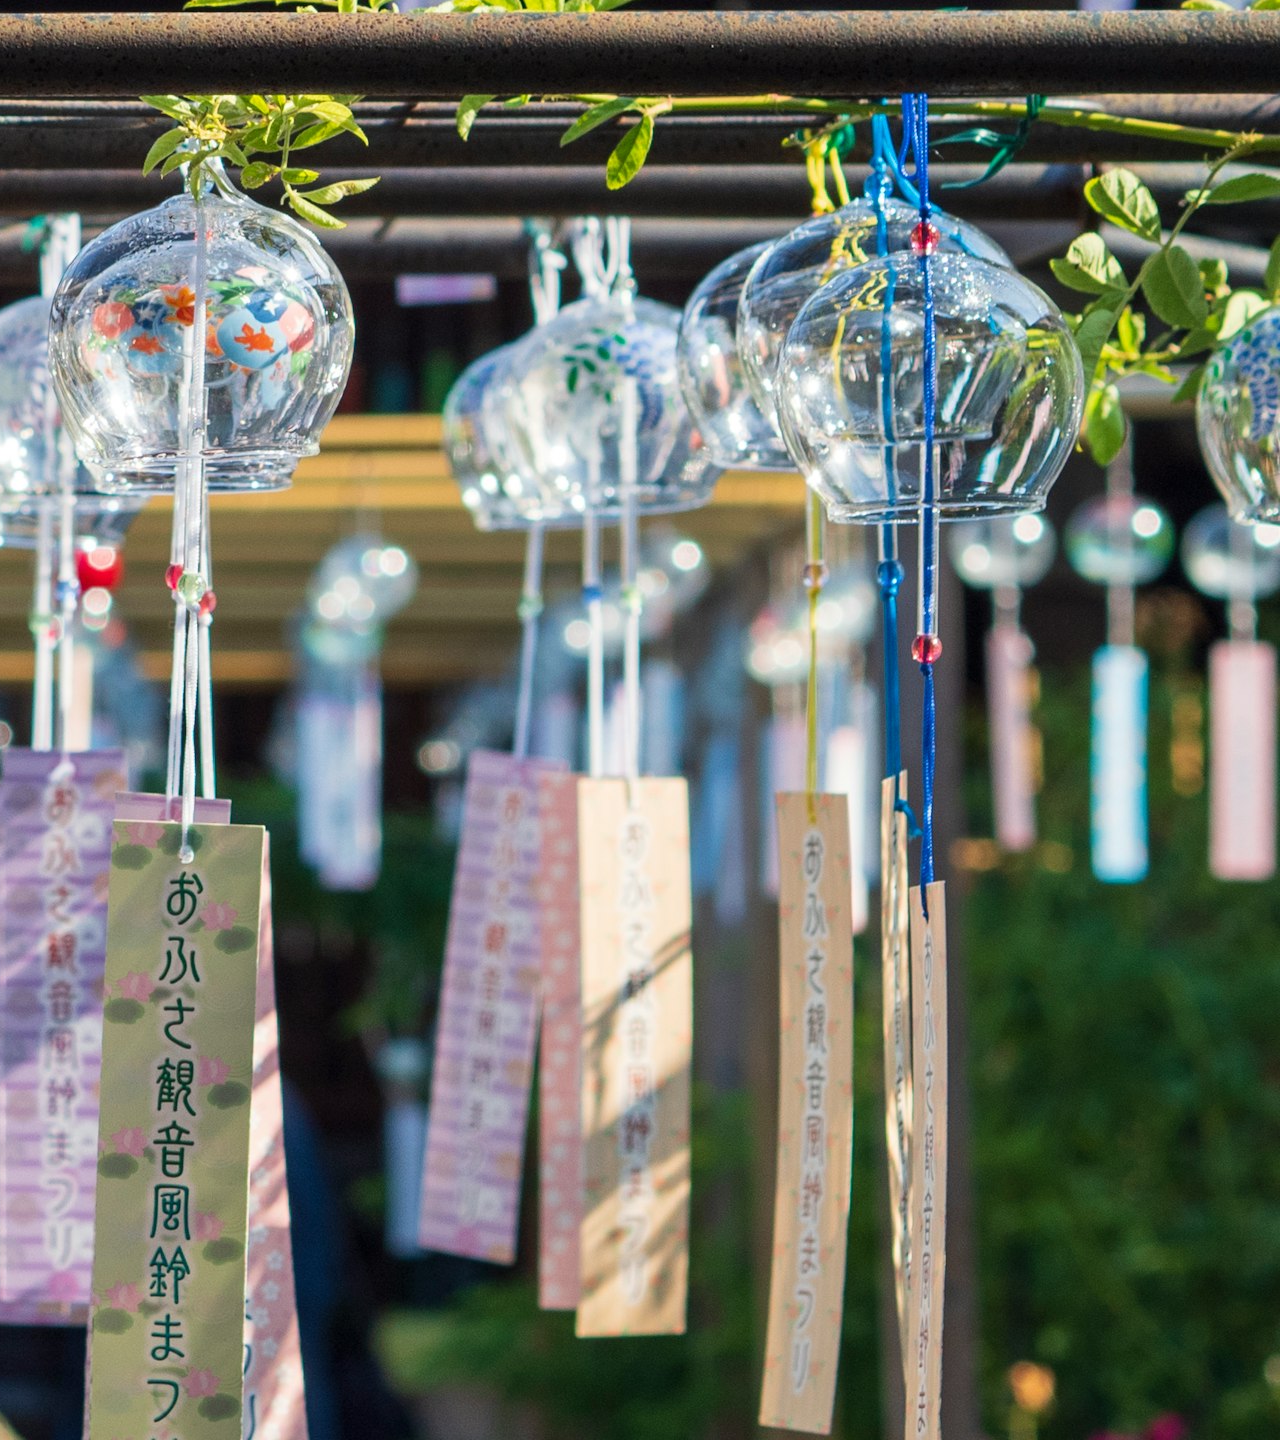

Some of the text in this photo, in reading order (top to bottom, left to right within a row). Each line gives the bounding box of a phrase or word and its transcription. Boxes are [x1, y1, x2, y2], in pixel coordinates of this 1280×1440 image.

[44, 784, 78, 1264] おふさ観音風鈴まつり
[147, 871, 204, 1440] おふさ観音風鈴まつ
[791, 834, 827, 1392] おふさ観音風鈴まつり
